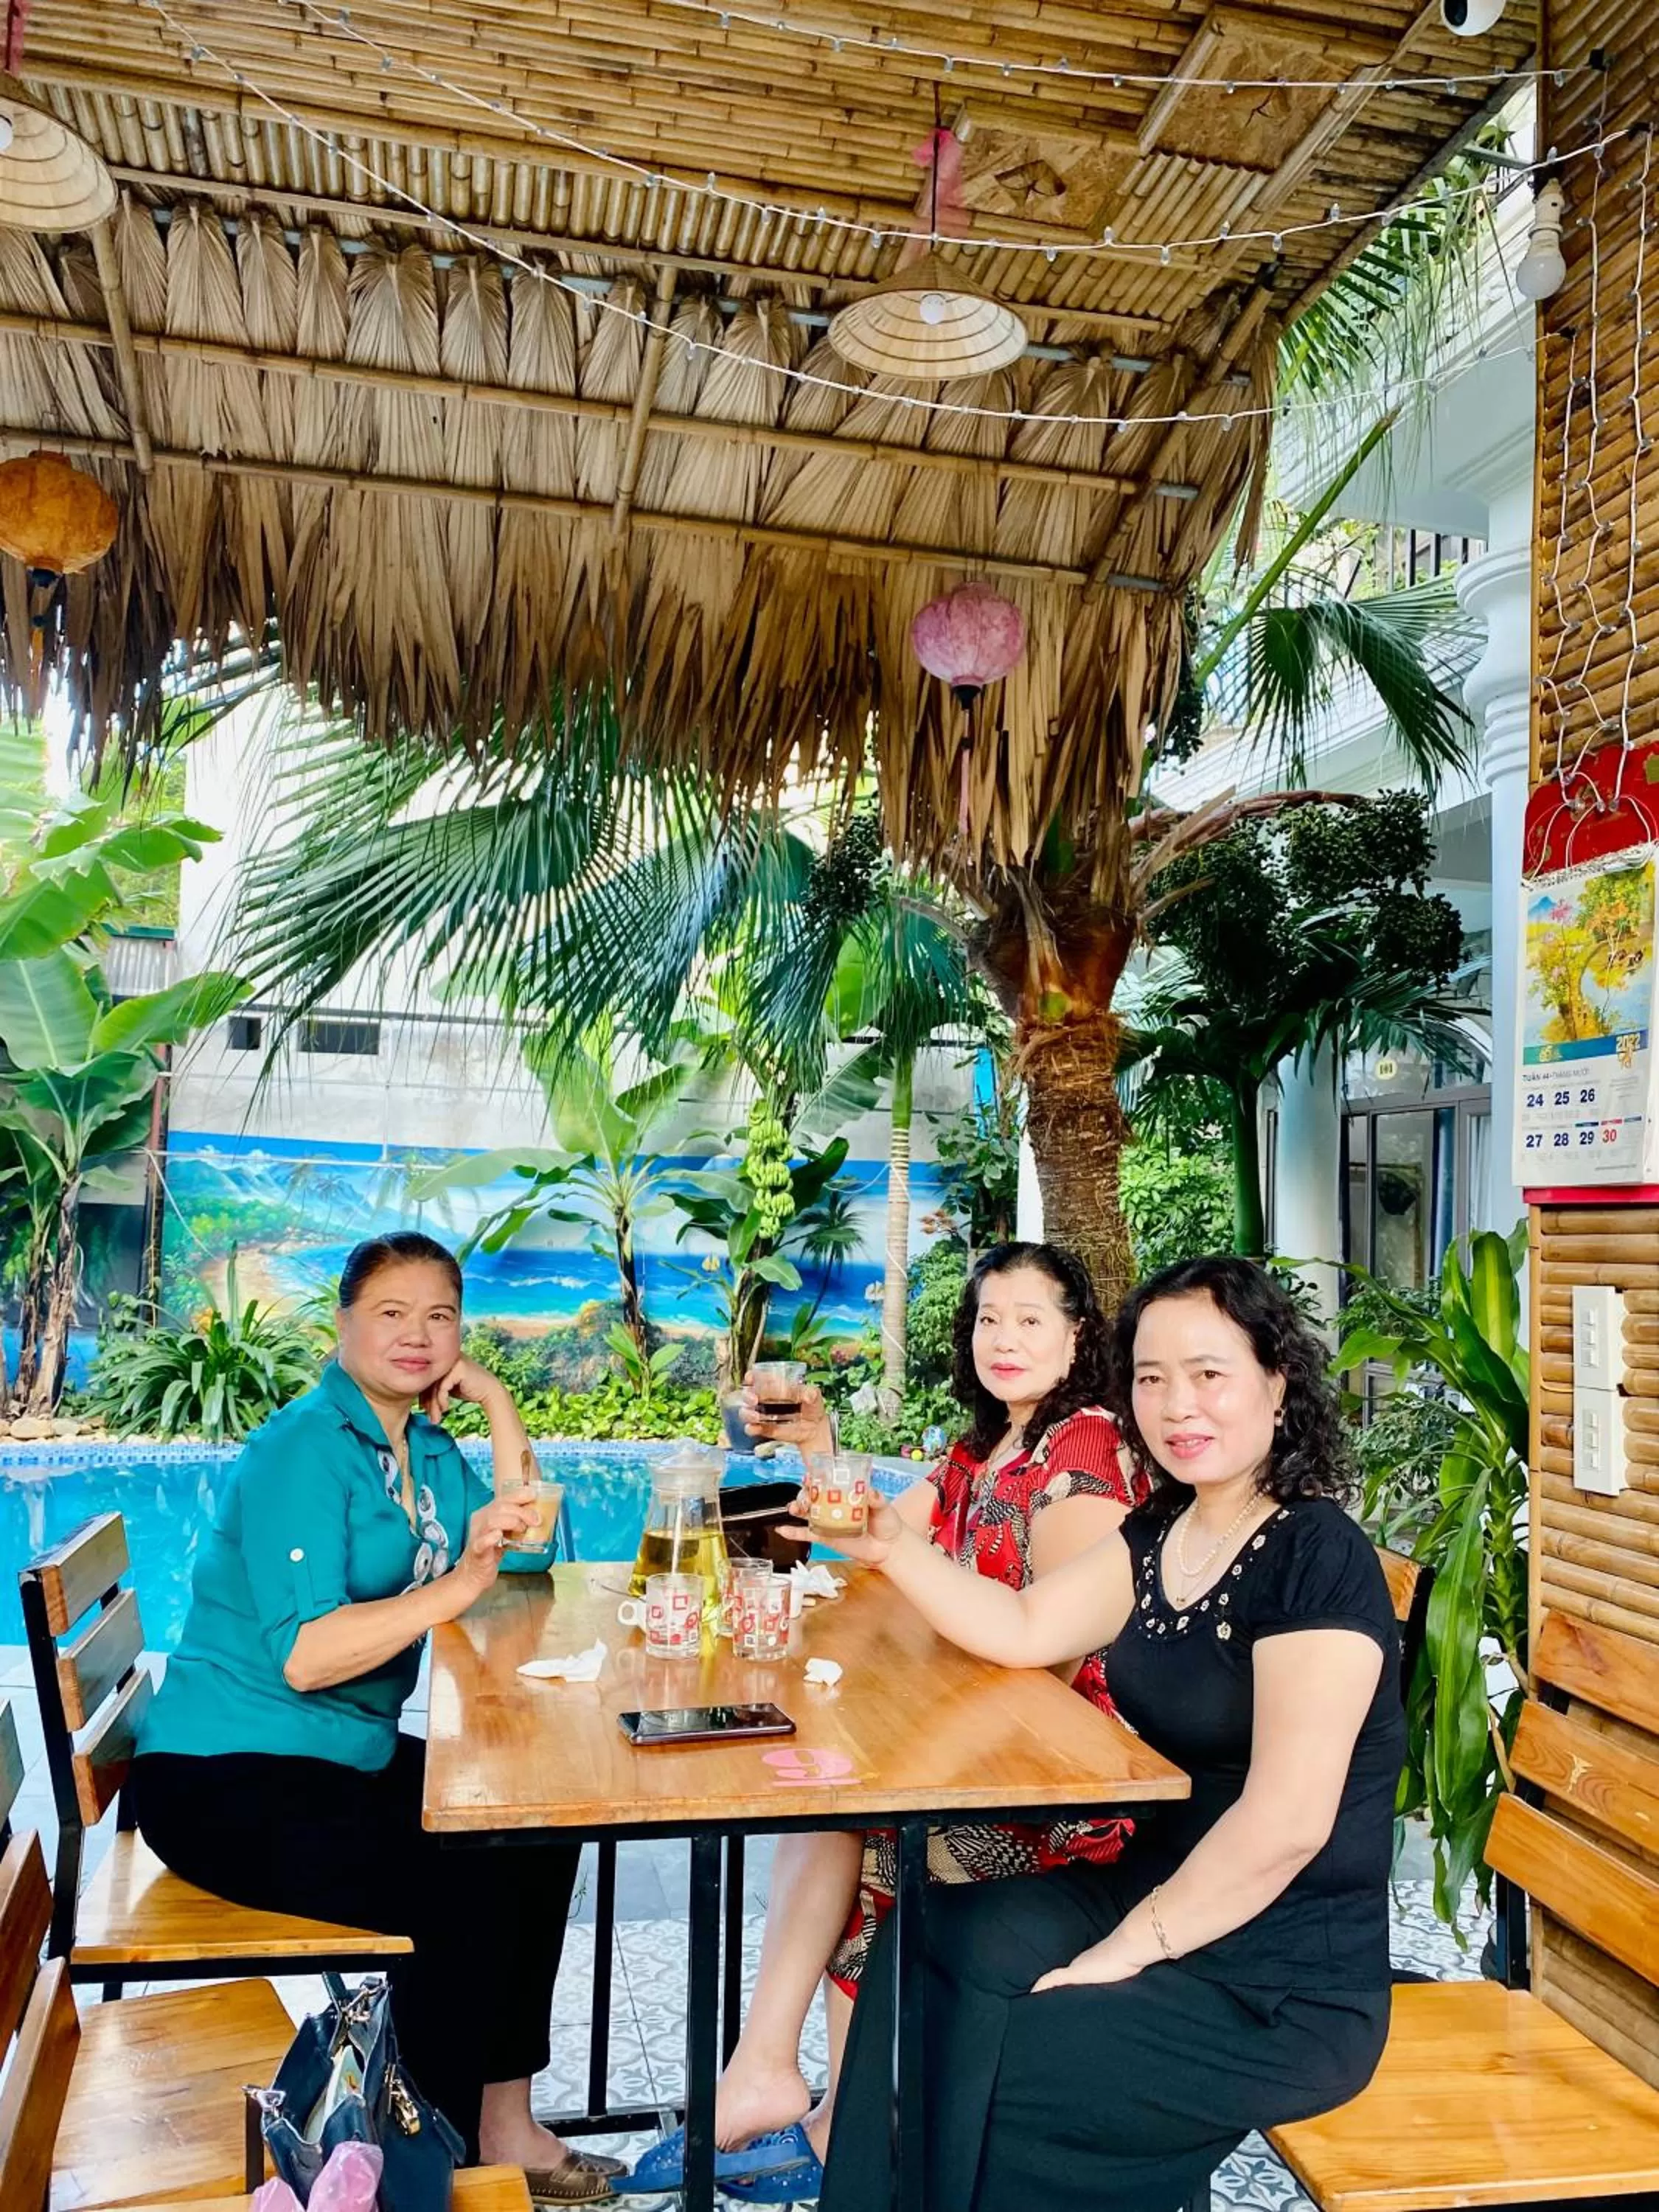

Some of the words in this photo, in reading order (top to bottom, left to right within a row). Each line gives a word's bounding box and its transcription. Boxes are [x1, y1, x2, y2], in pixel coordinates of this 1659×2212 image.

[1526, 1093, 1544, 1107] 24
[1554, 1091, 1570, 1105] 25
[1580, 1088, 1595, 1103] 26
[1526, 1134, 1543, 1148] 27
[1554, 1132, 1569, 1147] 28
[1579, 1130, 1594, 1145] 29
[1602, 1129, 1617, 1143] 30
